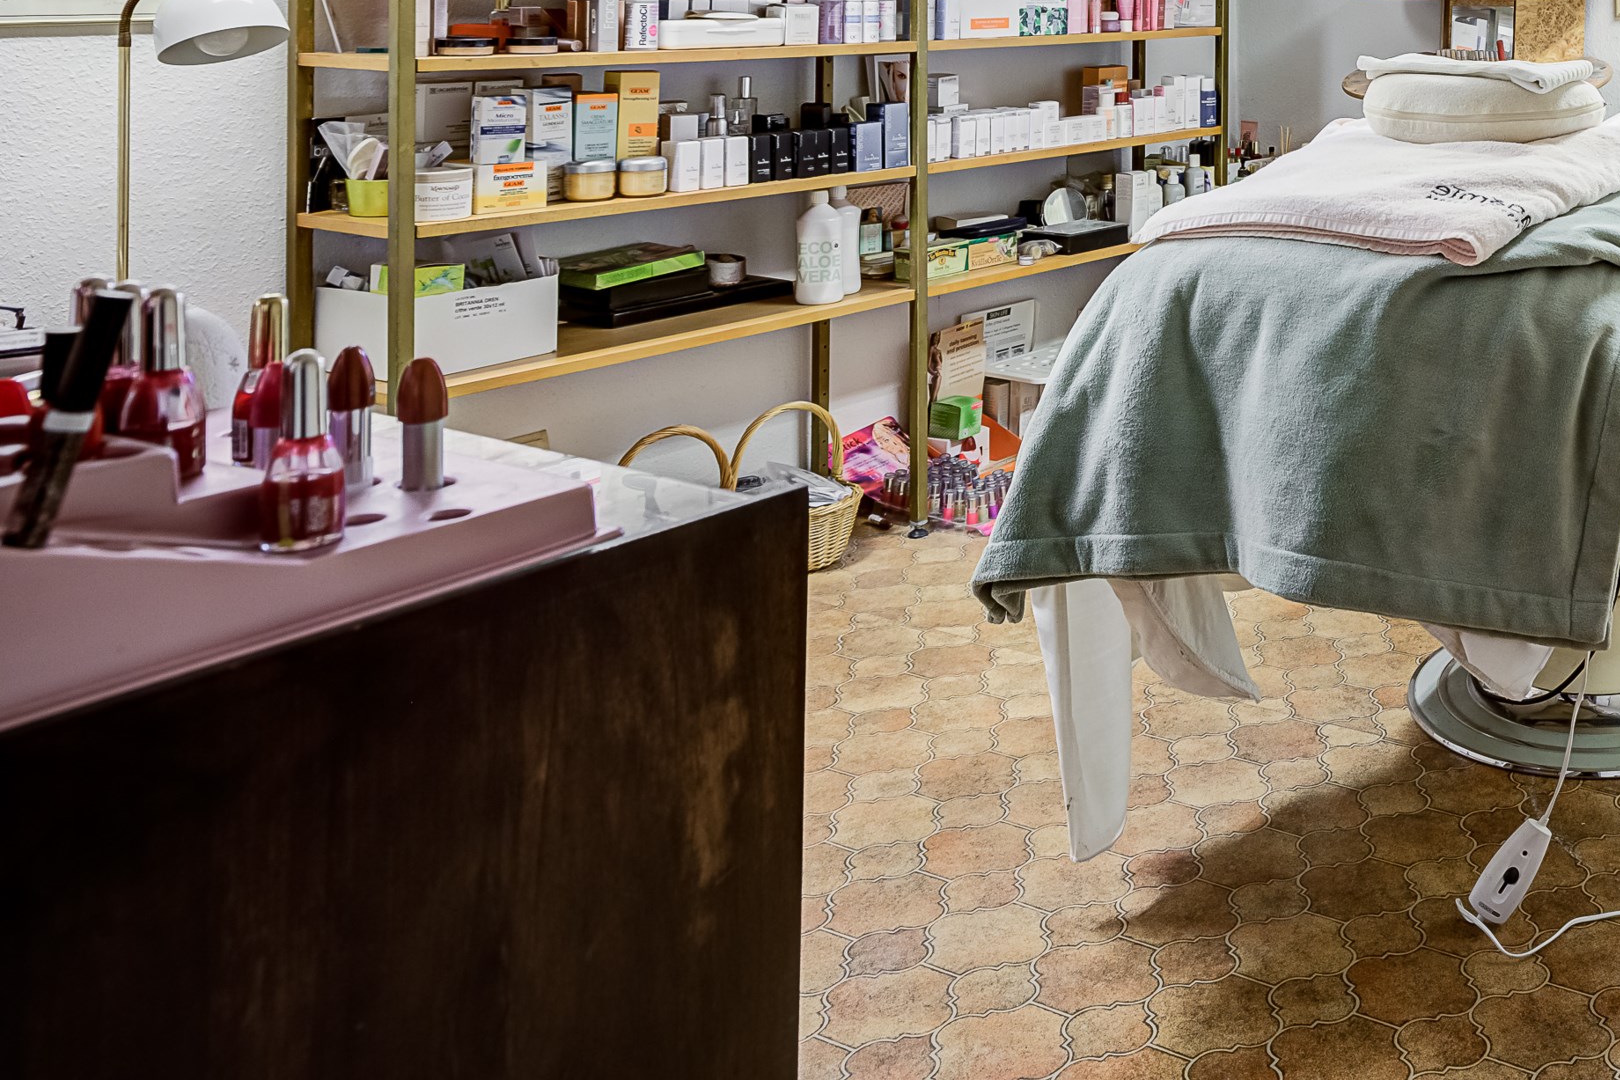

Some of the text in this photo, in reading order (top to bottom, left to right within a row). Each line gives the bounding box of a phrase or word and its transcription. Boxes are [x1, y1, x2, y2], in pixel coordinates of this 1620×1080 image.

[638, 4, 648, 46] RefectoCil
[441, 193, 450, 201] of
[798, 241, 833, 255] ECO
[798, 255, 840, 269] ALOE
[796, 269, 841, 283] VERA
[843, 437, 863, 452] tick
